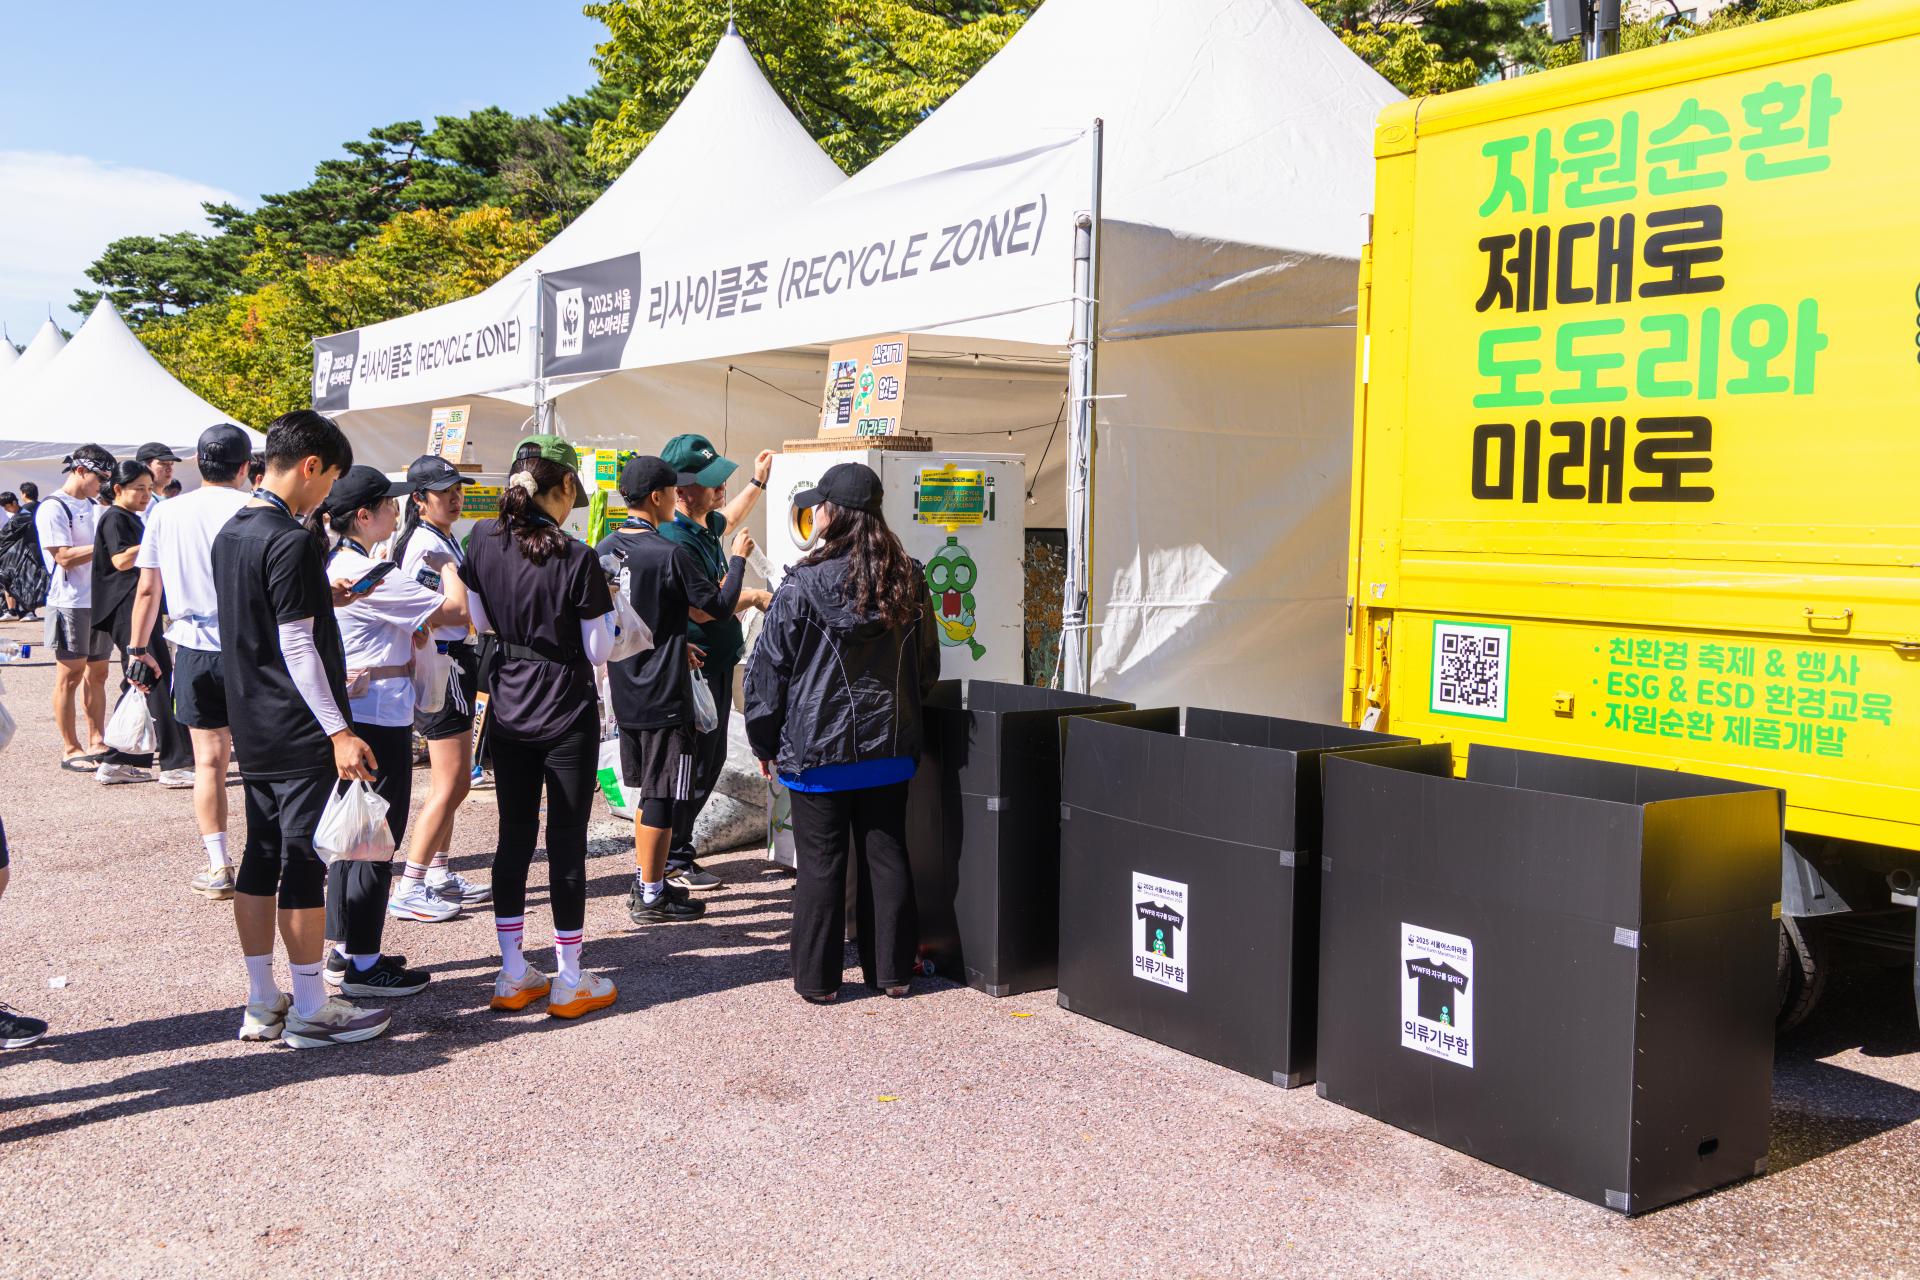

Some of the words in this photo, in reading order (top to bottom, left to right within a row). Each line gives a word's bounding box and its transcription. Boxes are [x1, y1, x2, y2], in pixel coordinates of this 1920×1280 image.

[1478, 73, 1842, 218] 자원순환
[648, 259, 769, 329] 리사이클존
[777, 232, 928, 309] (RECYCLE
[929, 193, 1048, 272] ZONE)
[1475, 204, 1725, 313] 제대로
[588, 296, 613, 315] 2025
[613, 288, 632, 312] 서울
[588, 312, 631, 339] 어스마라톤
[360, 342, 413, 383] 리사이클존
[416, 332, 473, 376] (RECYCLE
[476, 316, 521, 359] ZONE)
[872, 342, 903, 366] 쓰레기
[1472, 297, 1829, 409] 도도리와
[878, 376, 899, 400] 없는
[1471, 415, 1715, 504] 미래로
[1608, 637, 1689, 672] 친환경
[1696, 643, 1756, 677] 축제
[1764, 648, 1786, 678] &
[1796, 650, 1860, 686] 행사
[1607, 671, 1660, 700] ESG
[1668, 675, 1688, 703] &
[1697, 679, 1755, 710] ESD
[1764, 683, 1893, 727] 환경교육
[1604, 702, 1716, 742] 자원순환
[1722, 714, 1848, 759] 제품개발
[1135, 955, 1185, 983] 의류기부함
[1416, 936, 1430, 945] 2025
[1430, 941, 1468, 956] 서울어스마라톤
[1411, 964, 1431, 977] WWF와
[1431, 970, 1447, 981] 지구를
[1447, 974, 1464, 985] 달리다
[1404, 1020, 1469, 1056] 의류기부함
